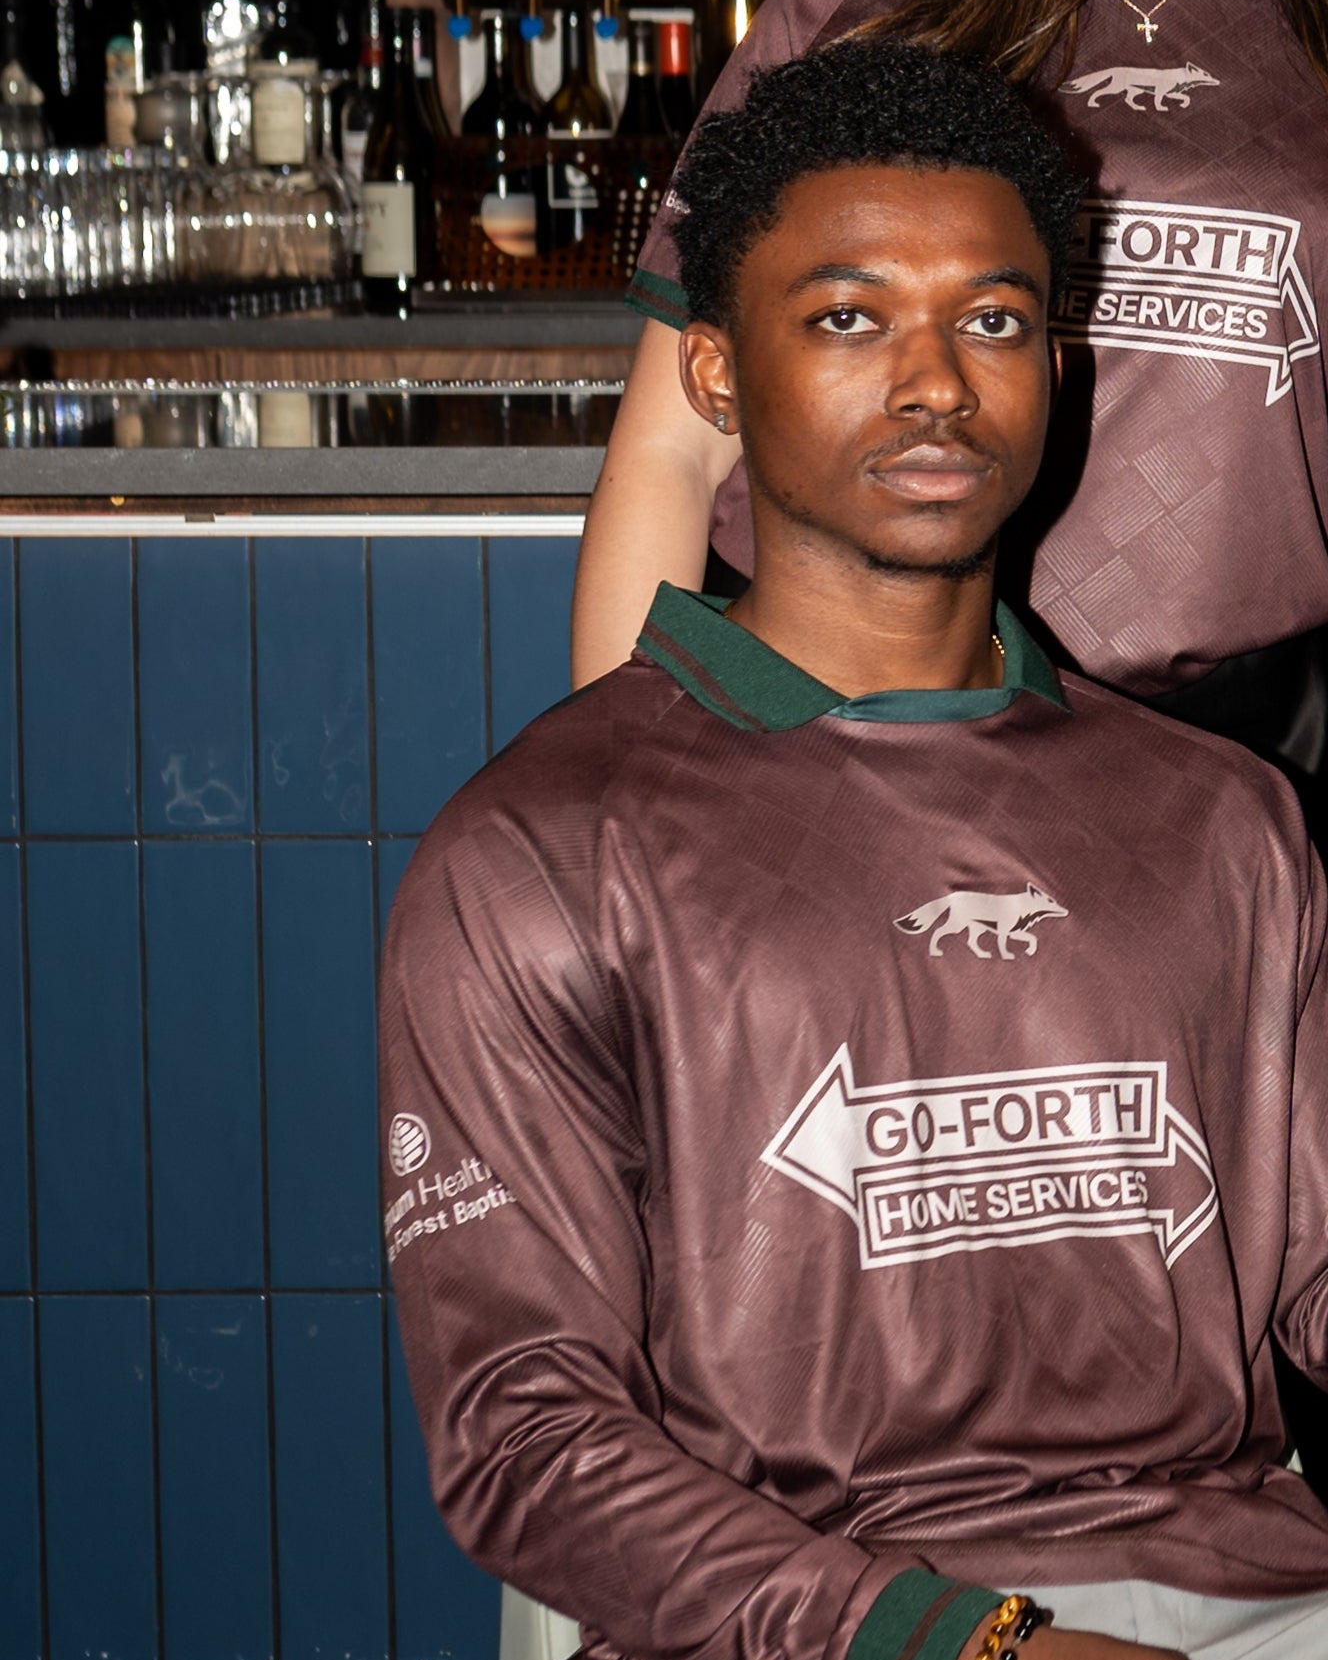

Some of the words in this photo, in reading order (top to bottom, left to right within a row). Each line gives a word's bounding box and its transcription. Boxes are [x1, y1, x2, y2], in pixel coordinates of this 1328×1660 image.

[1095, 292, 1268, 339] SERVICES
[866, 1084, 1143, 1158] GO-FORTH
[877, 1187, 980, 1235] HOME
[986, 1171, 1148, 1219] SERVICES
